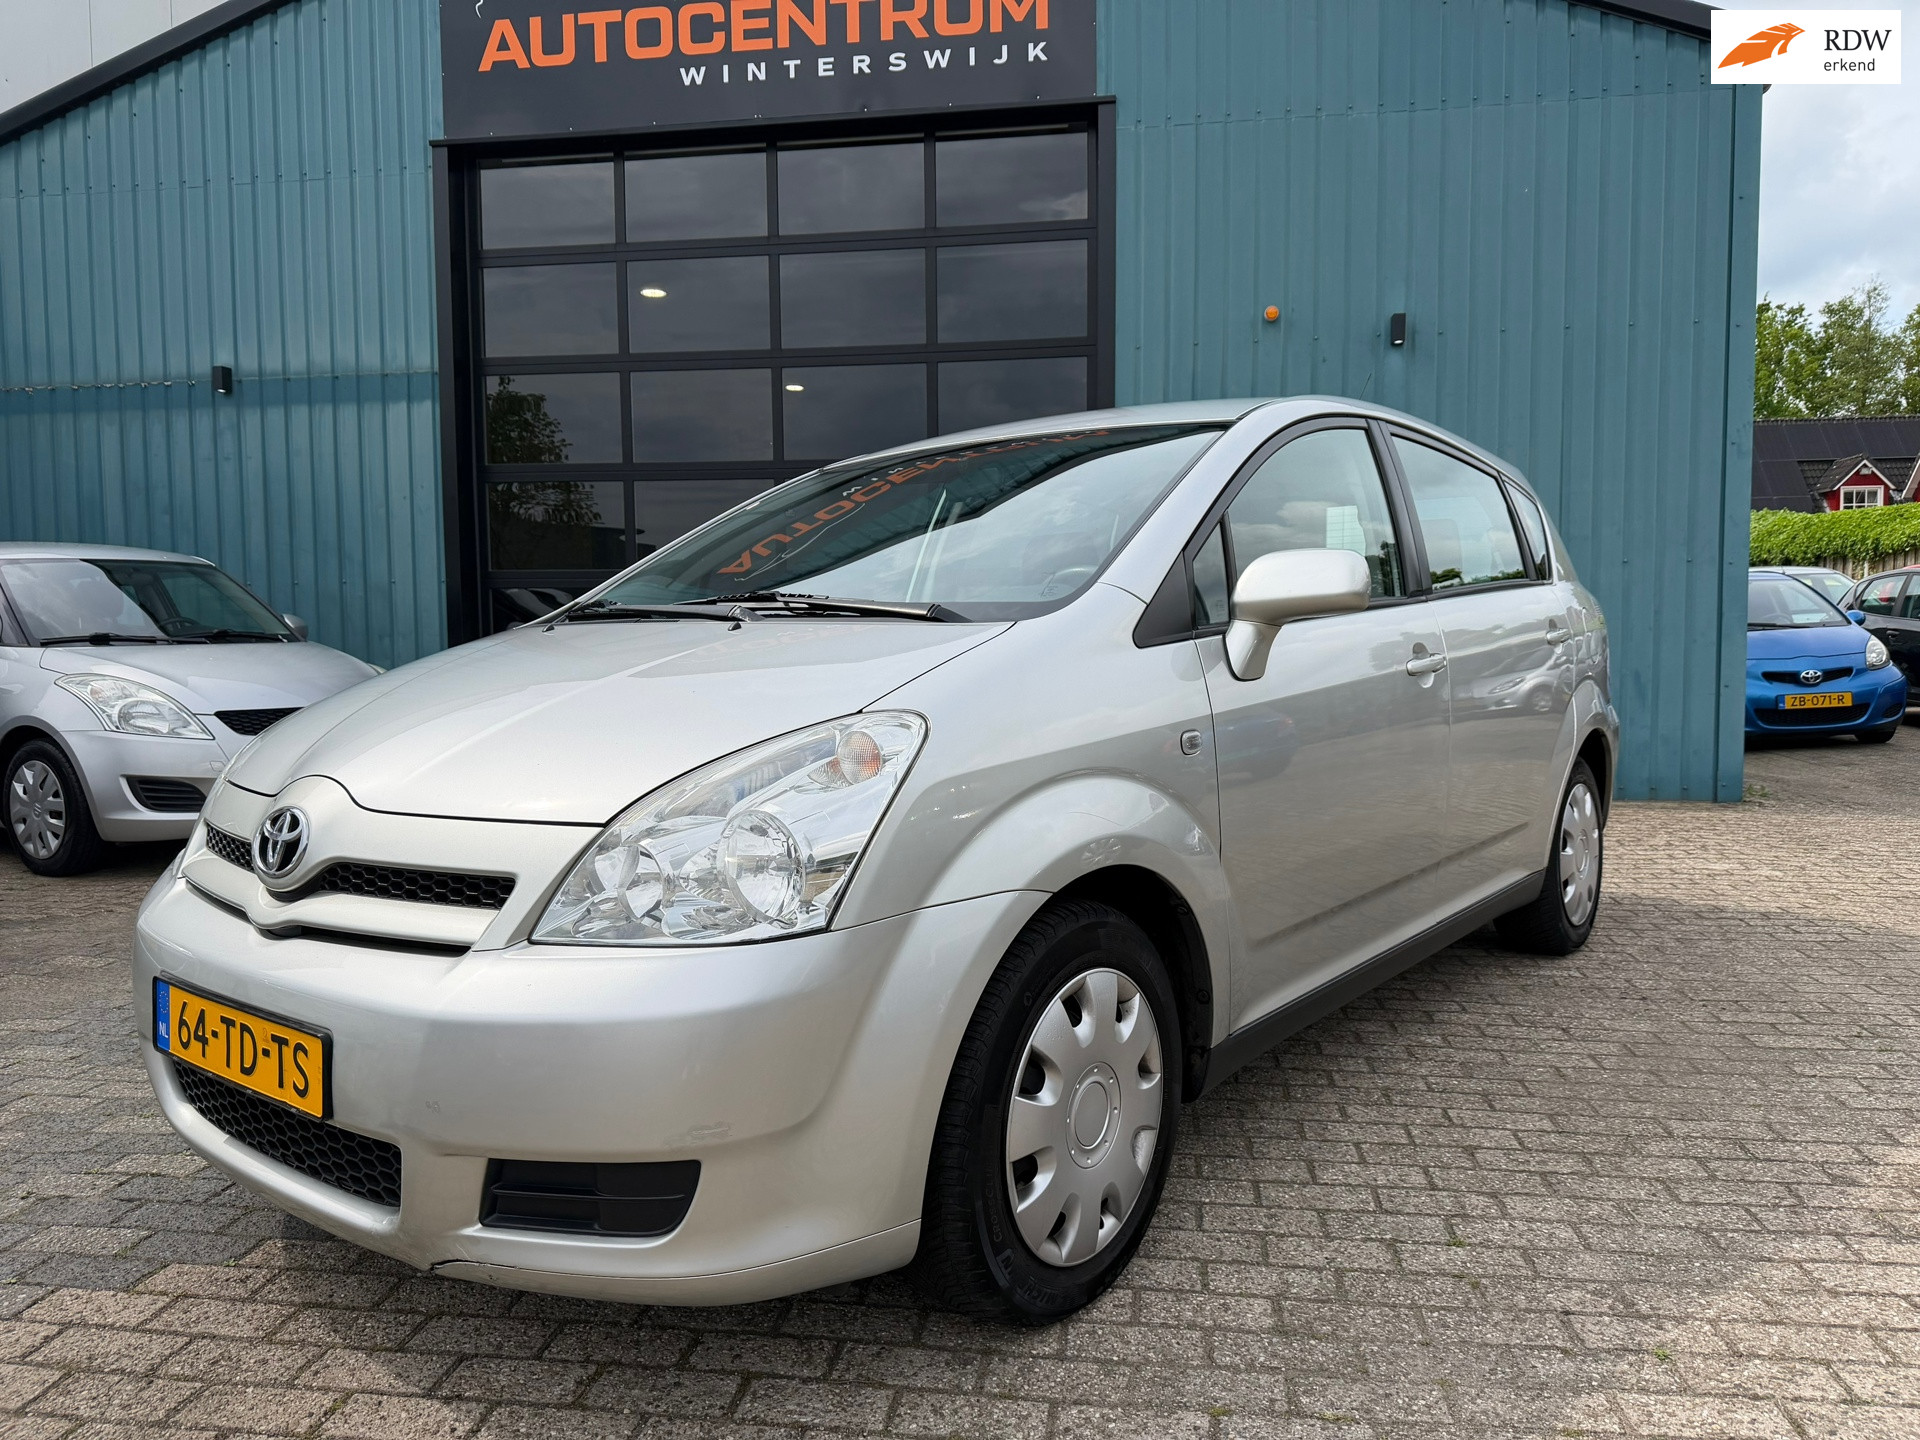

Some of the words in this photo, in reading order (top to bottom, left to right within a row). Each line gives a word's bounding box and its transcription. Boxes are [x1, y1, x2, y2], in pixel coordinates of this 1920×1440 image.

[478, 0, 1049, 72] AUTOCENTRUM
[679, 41, 1048, 87] WINTERSWIJK
[1790, 694, 1845, 707] ZB-071-R
[159, 1021, 169, 1039] NL
[177, 1000, 310, 1099] 64-TD-TS
